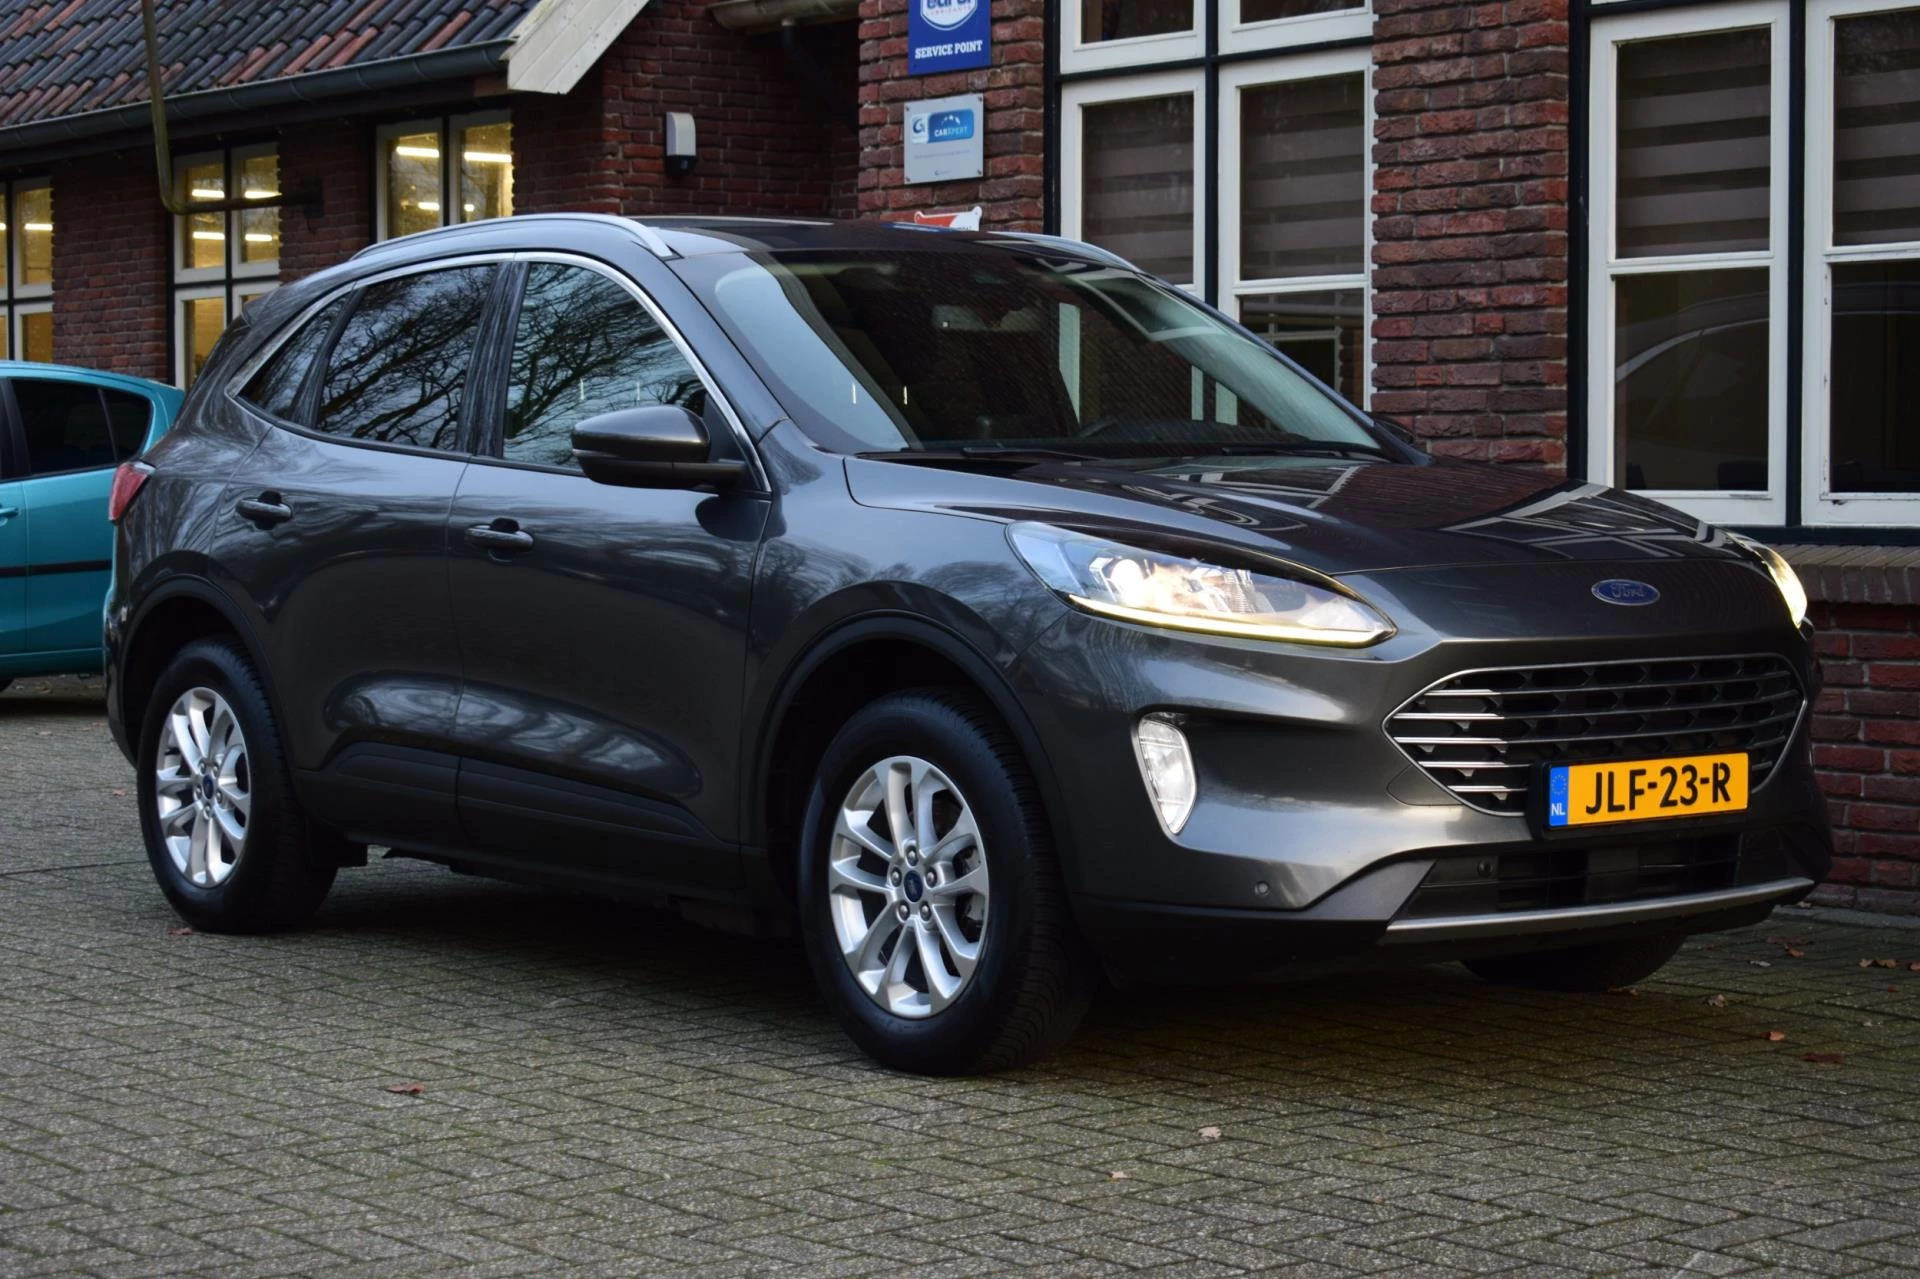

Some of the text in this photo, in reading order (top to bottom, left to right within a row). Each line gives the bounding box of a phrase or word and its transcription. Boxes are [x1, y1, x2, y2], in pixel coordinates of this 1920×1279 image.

[915, 40, 983, 59] SERVICE POINT
[1585, 762, 1732, 815] JLF-23-R
[1551, 803, 1566, 817] NL
